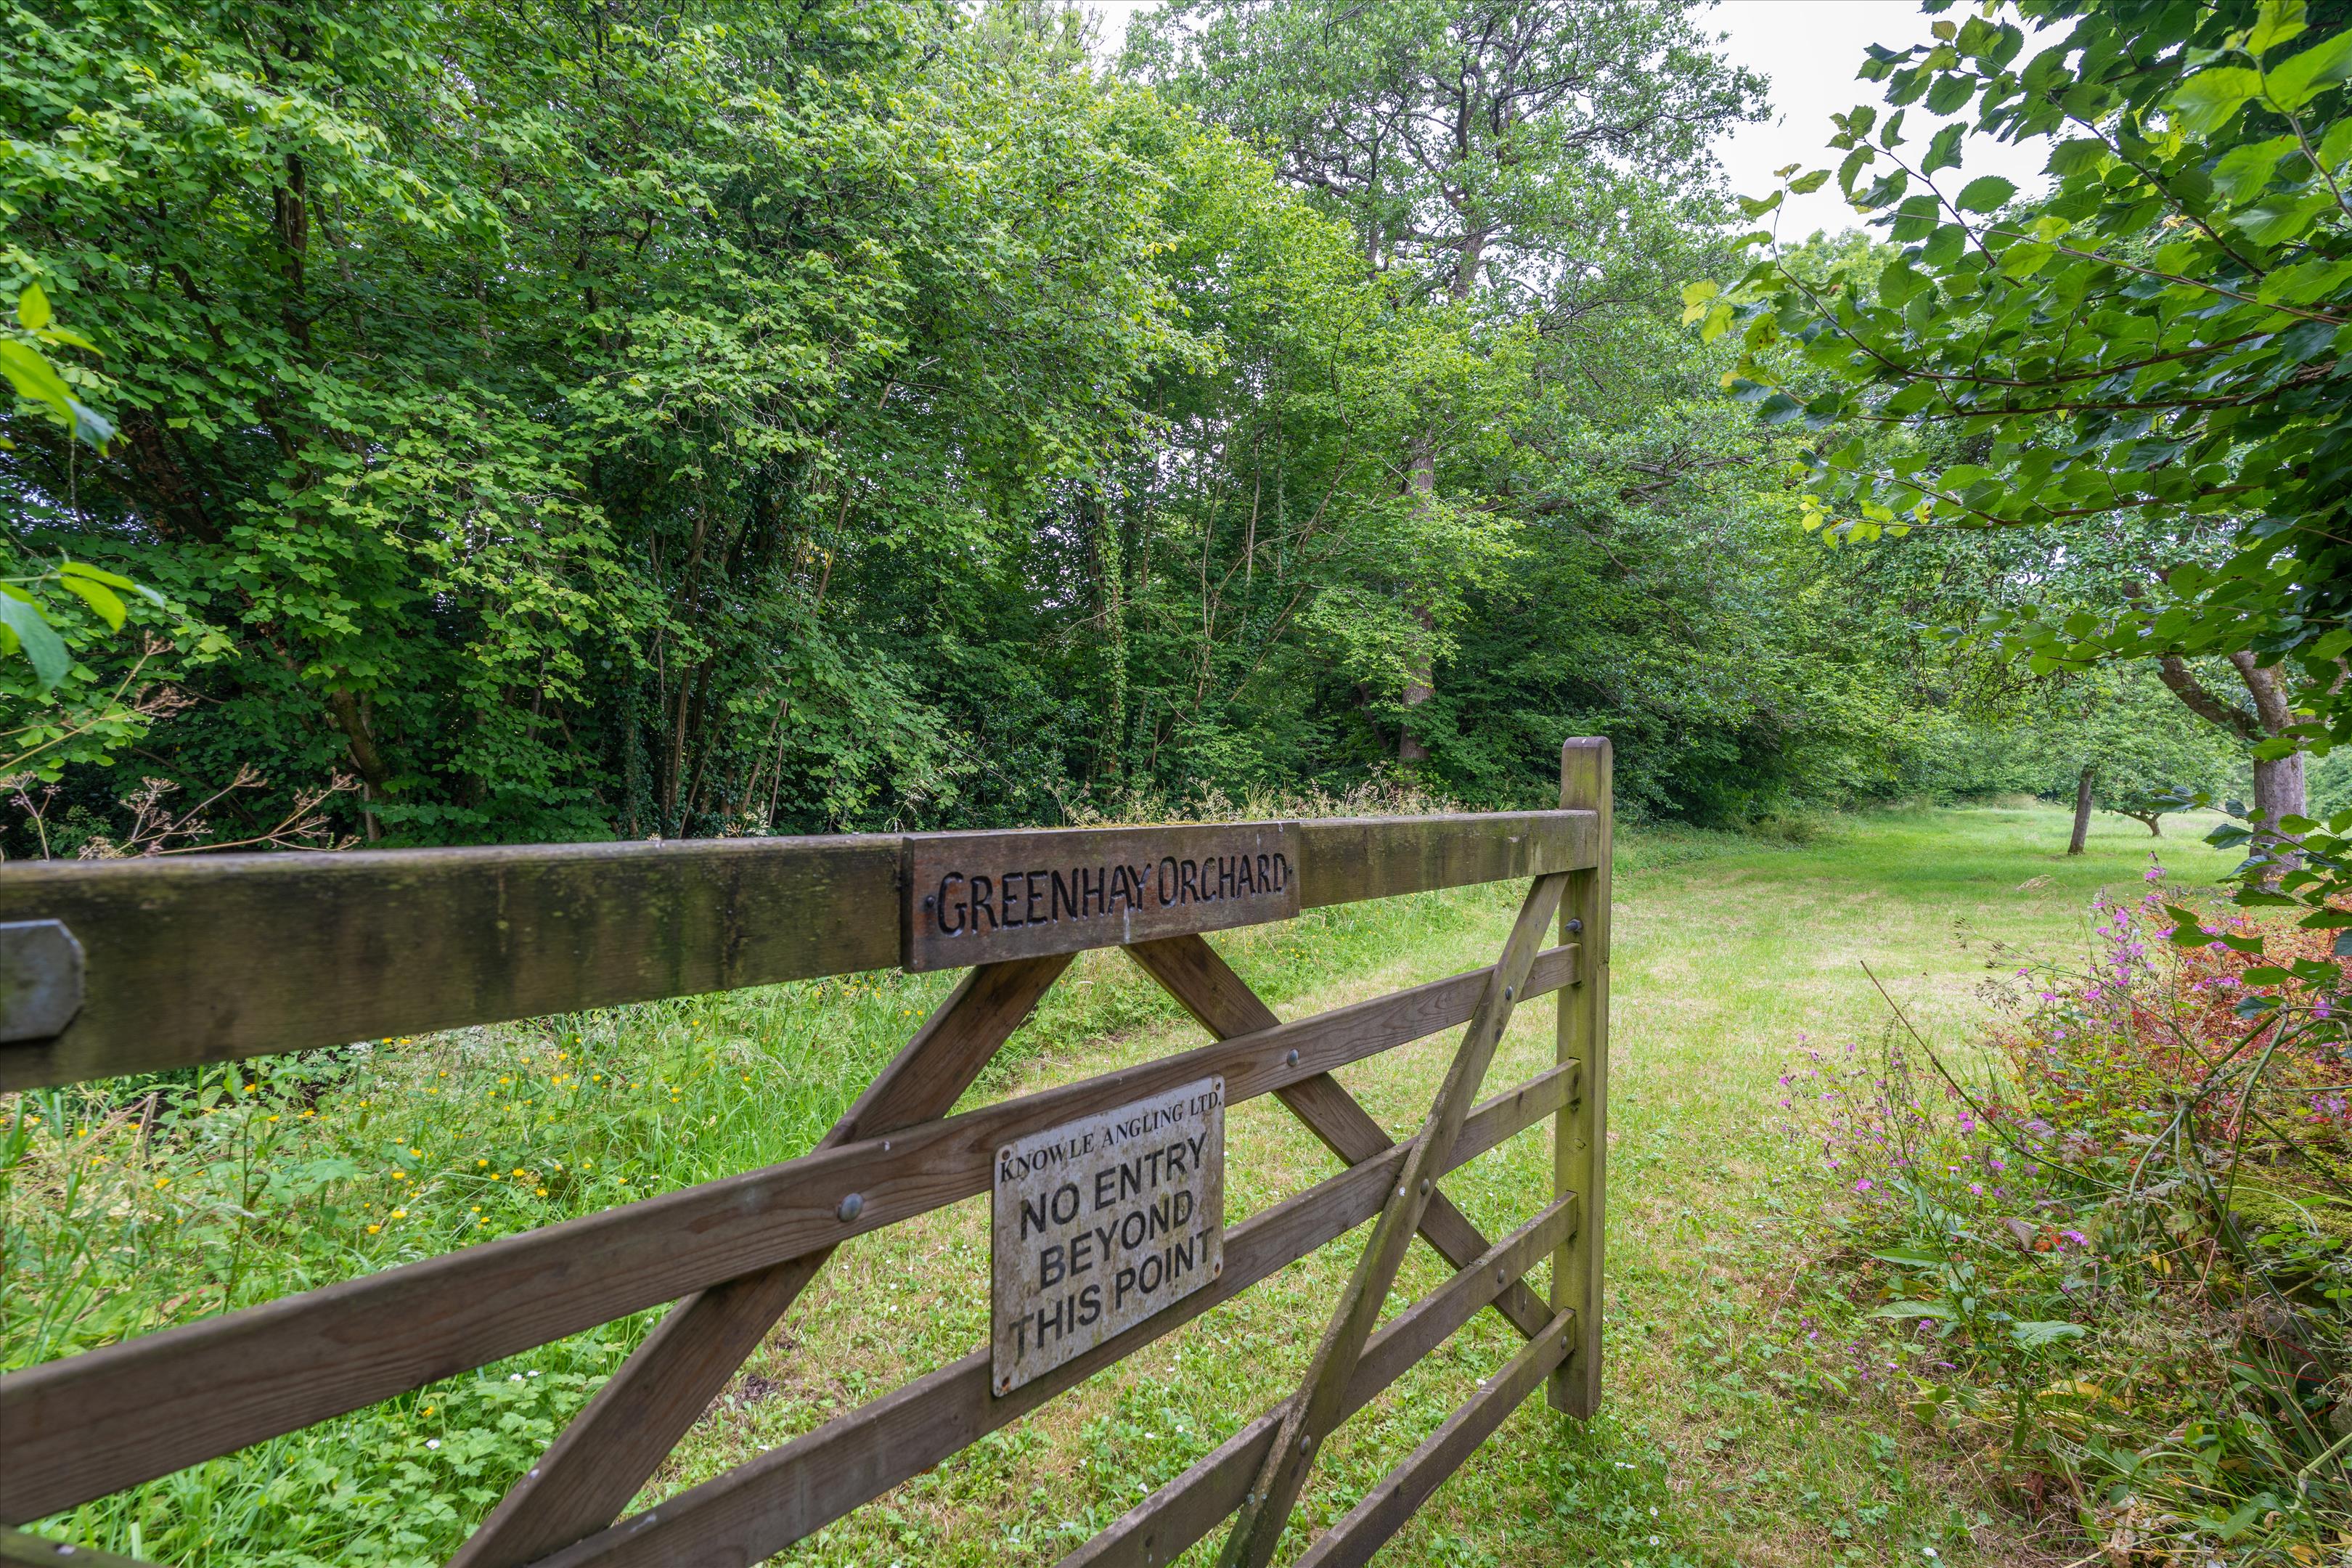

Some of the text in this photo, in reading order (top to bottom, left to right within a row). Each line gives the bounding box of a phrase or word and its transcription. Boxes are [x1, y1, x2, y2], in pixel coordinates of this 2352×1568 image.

[936, 852, 1289, 938] GREENHAY ORCHARD
[1000, 1091, 1222, 1183] KNOWLE ANGLING LTD.
[1021, 1132, 1207, 1241] NO ENTRY
[1040, 1190, 1193, 1290] BEYOND
[1009, 1226, 1214, 1359] THIS POINT
